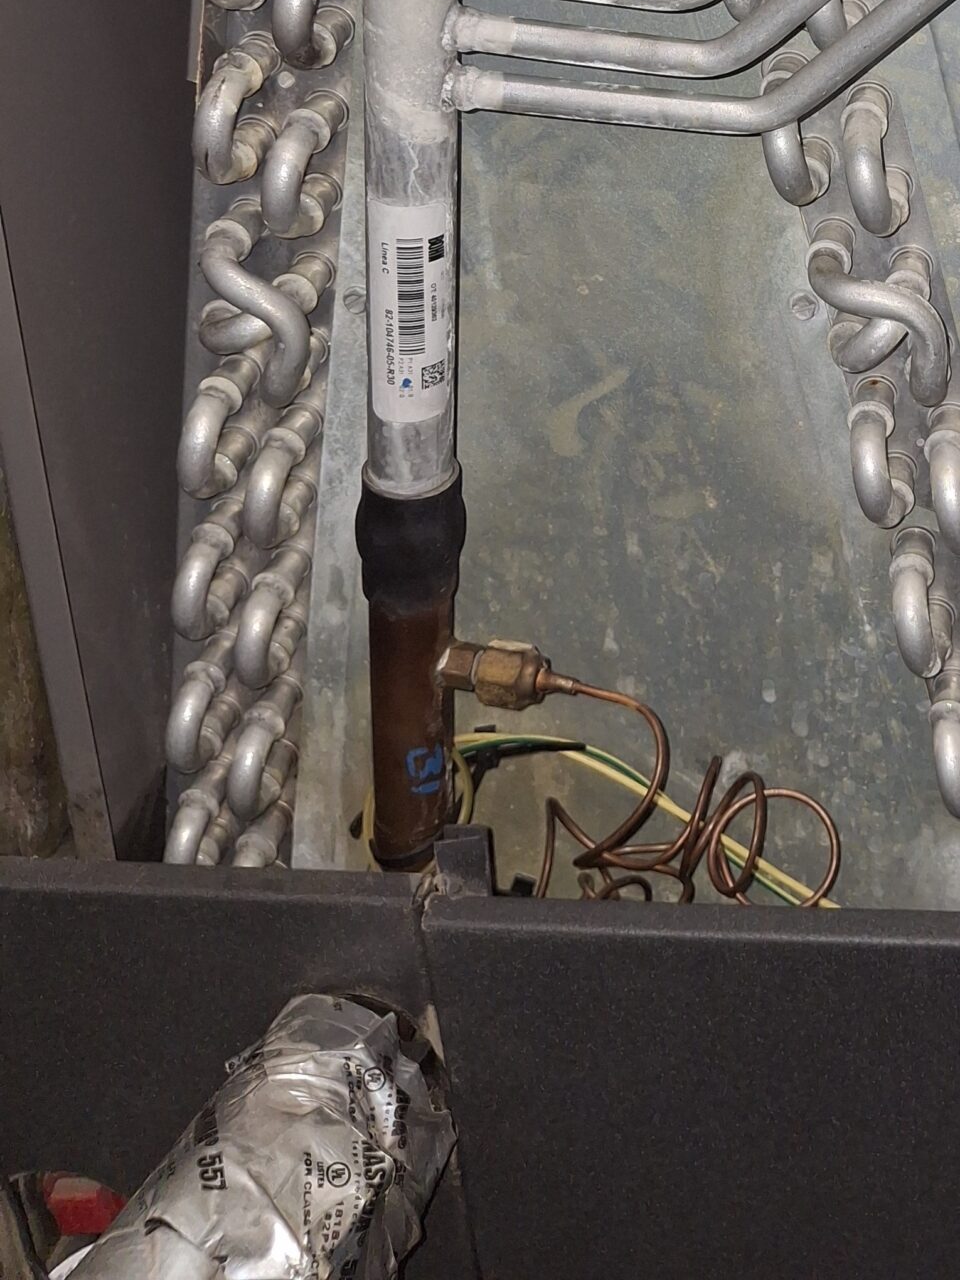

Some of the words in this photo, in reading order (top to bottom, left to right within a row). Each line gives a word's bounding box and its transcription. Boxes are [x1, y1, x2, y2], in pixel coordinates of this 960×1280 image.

[382, 267, 390, 275] C
[196, 1150, 228, 1191] 557
[302, 1151, 312, 1178] FOR
